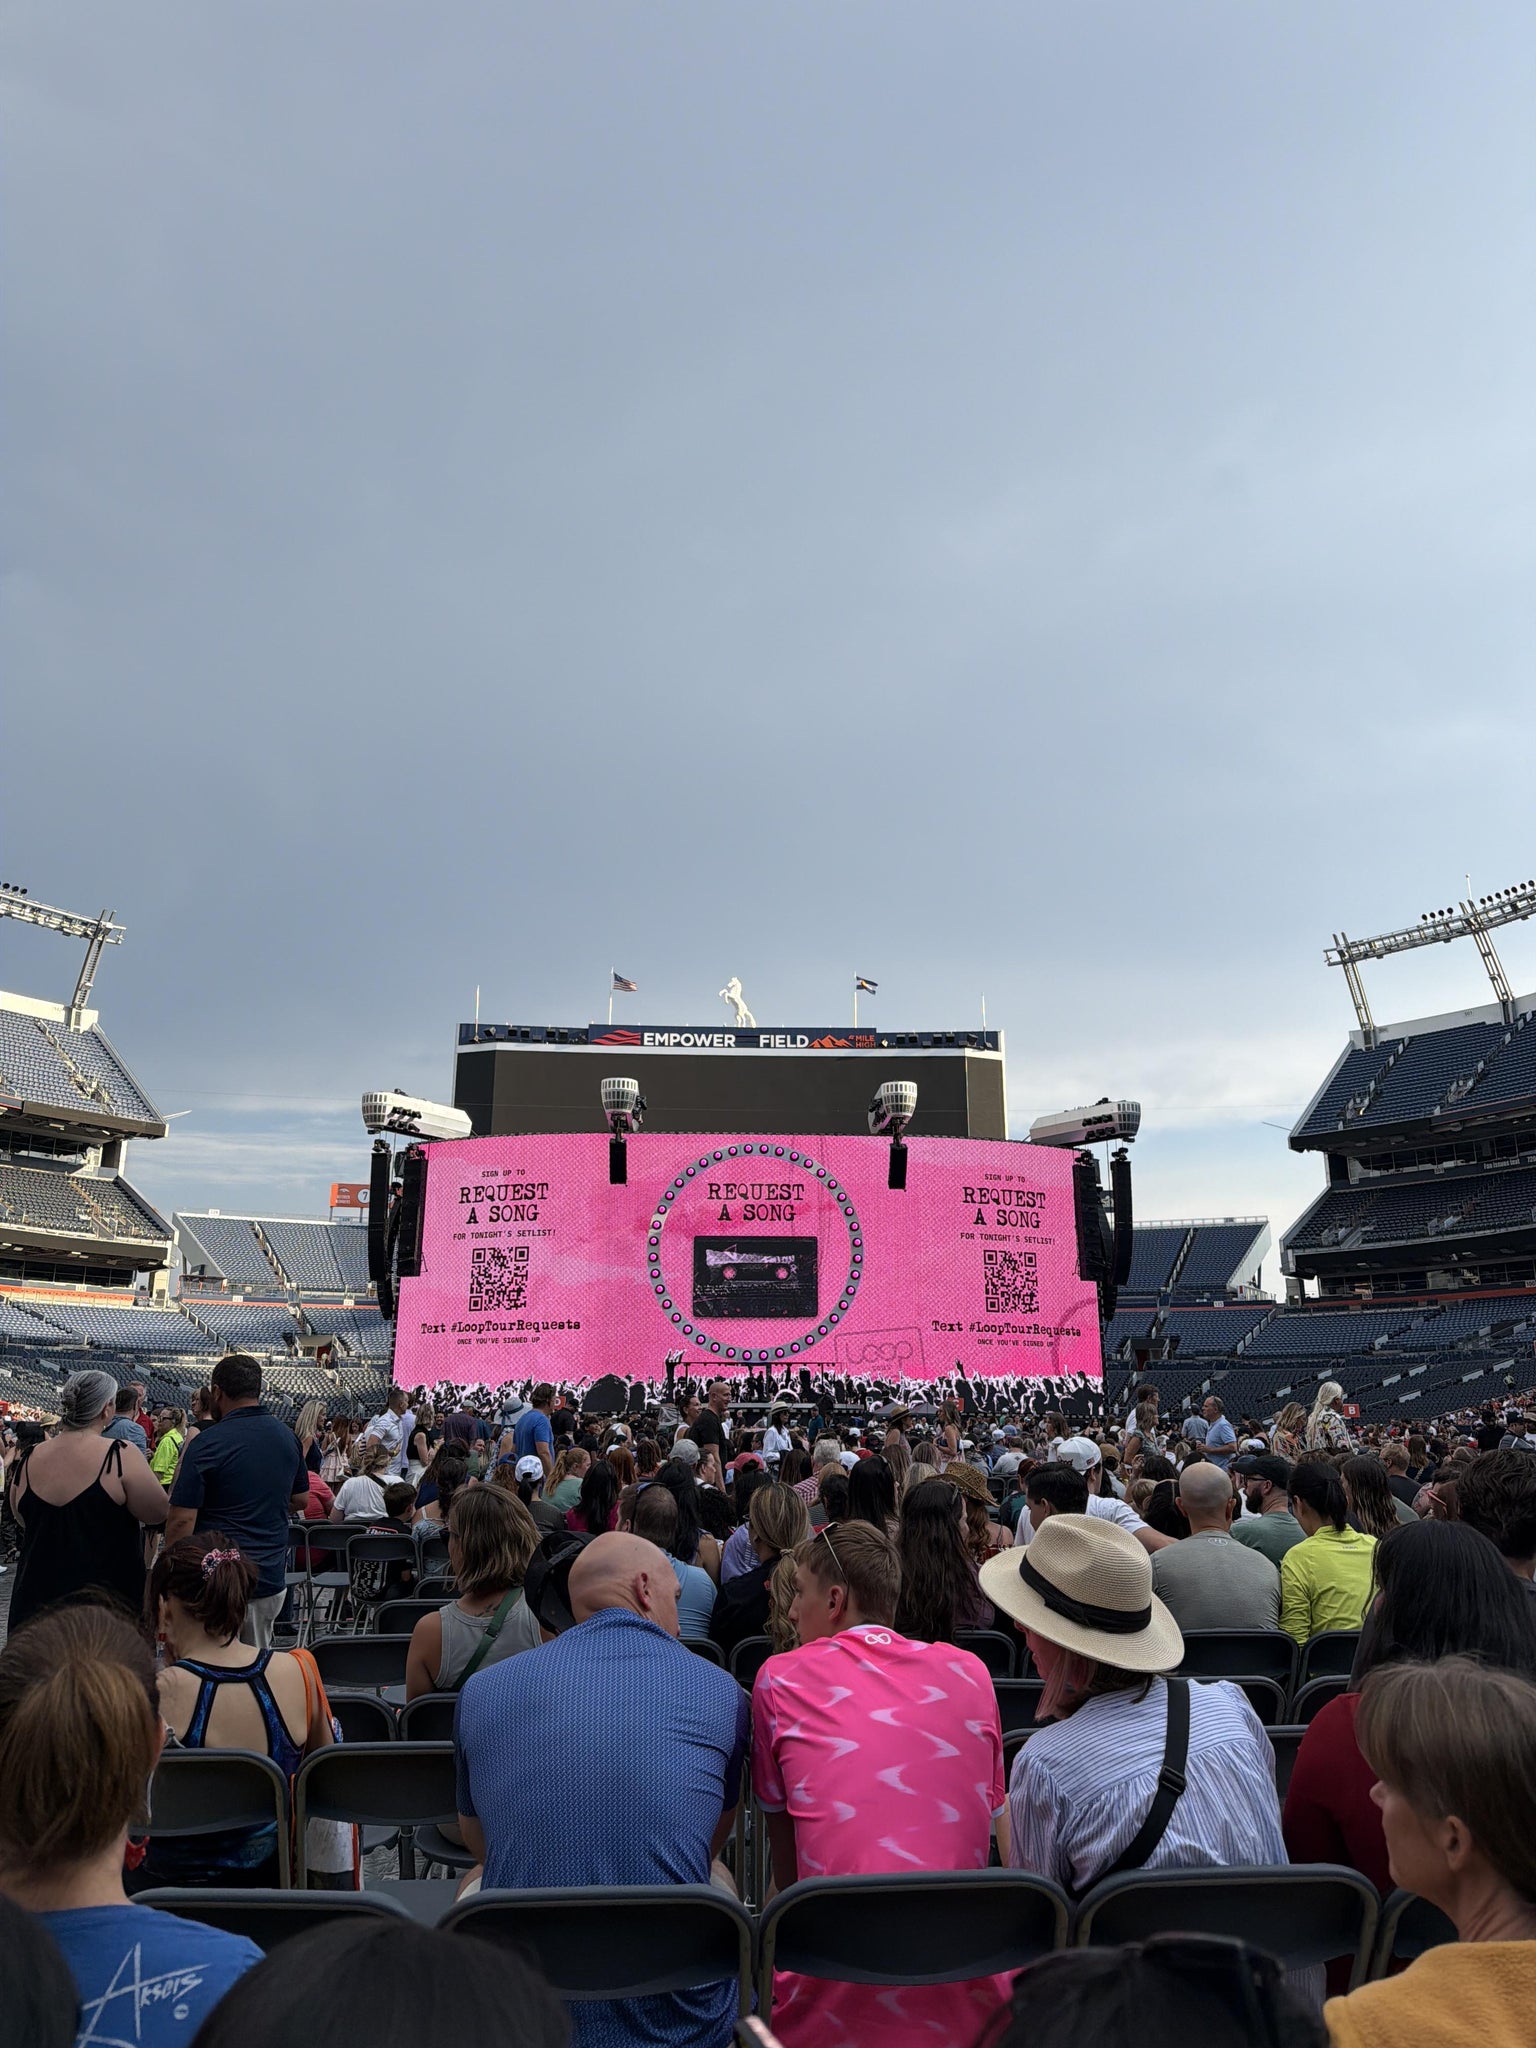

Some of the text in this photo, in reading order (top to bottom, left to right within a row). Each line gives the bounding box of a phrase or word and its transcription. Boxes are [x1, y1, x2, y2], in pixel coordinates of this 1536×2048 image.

[643, 1032, 810, 1048] EMPOWER FIELD
[481, 1170, 499, 1178] SIGN
[984, 1173, 1001, 1181] SIGN
[362, 1191, 368, 1201] 7
[458, 1182, 549, 1204] REQUEST
[707, 1183, 805, 1201] REQUEST
[962, 1186, 1046, 1209] REQUEST
[466, 1204, 540, 1224] A SONG
[717, 1204, 797, 1222] A SONG
[973, 1208, 1041, 1229] A SONG
[453, 1229, 556, 1241] FOR TONIGHT'S SETLIST!
[960, 1232, 1056, 1245] FOR TONIGHT'S SETLIST!
[421, 1319, 581, 1334] Text #LoopTourRequests
[932, 1320, 1081, 1338] Text #LoopTourRequests
[475, 1337, 500, 1345] YOU'VE
[977, 1338, 993, 1346] ONCE
[1348, 1406, 1356, 1415] B
